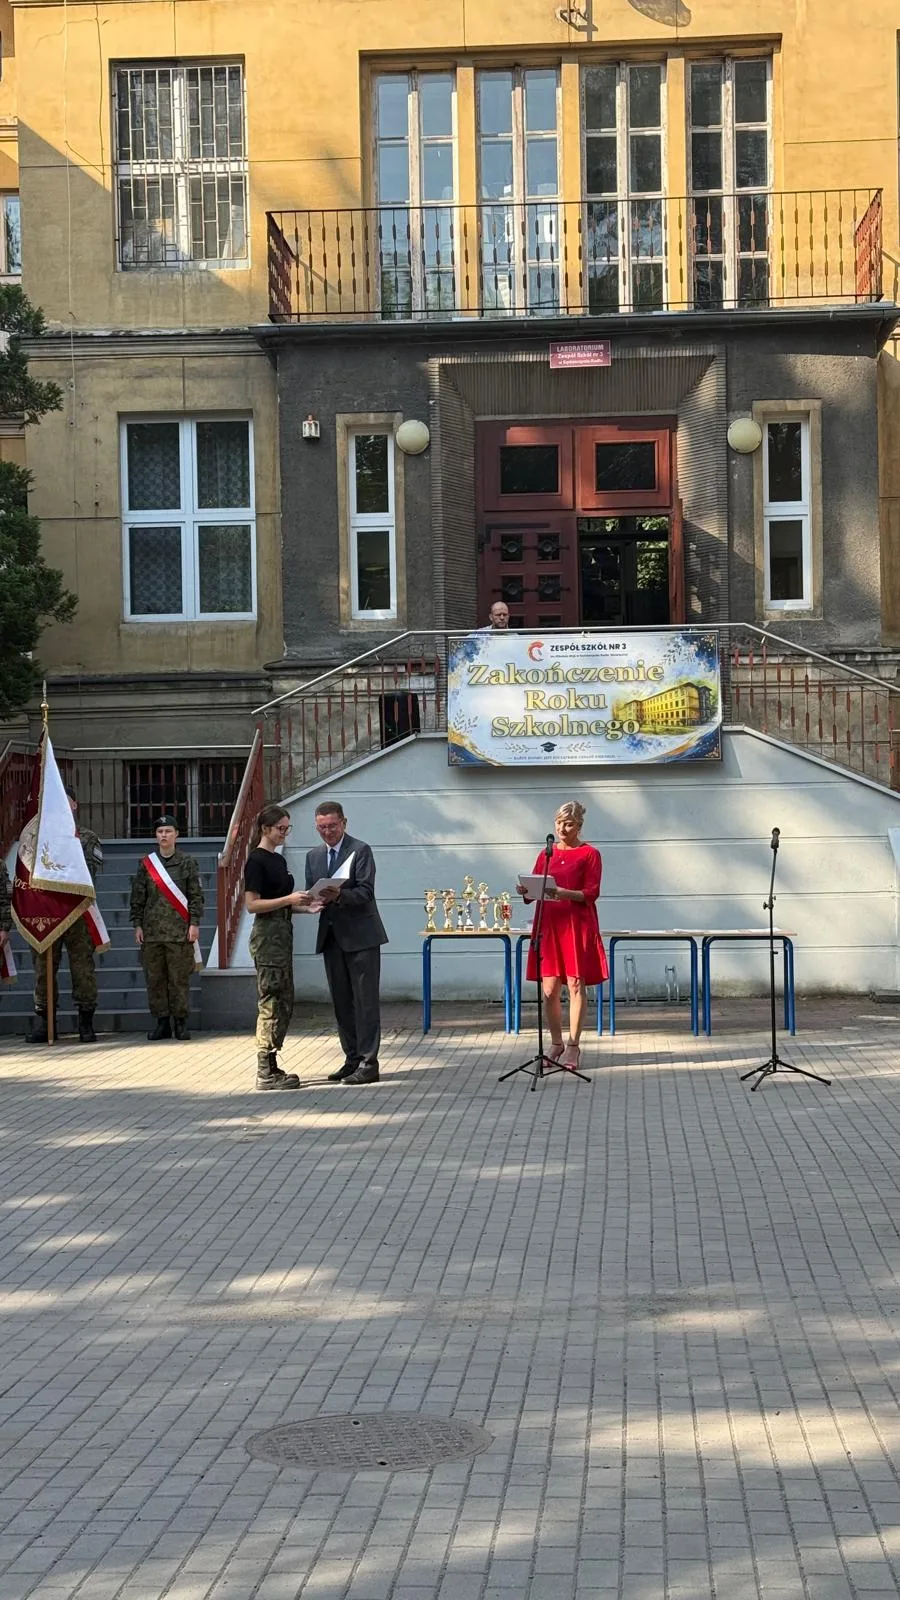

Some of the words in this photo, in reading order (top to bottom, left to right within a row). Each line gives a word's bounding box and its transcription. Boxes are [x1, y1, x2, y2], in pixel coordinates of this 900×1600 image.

[550, 642, 580, 651] ZESPÓŁ
[581, 641, 607, 651] SZKÓŁ
[467, 659, 665, 686] Zakończenie
[524, 688, 608, 711] Roku
[491, 714, 641, 741] Szkolnego
